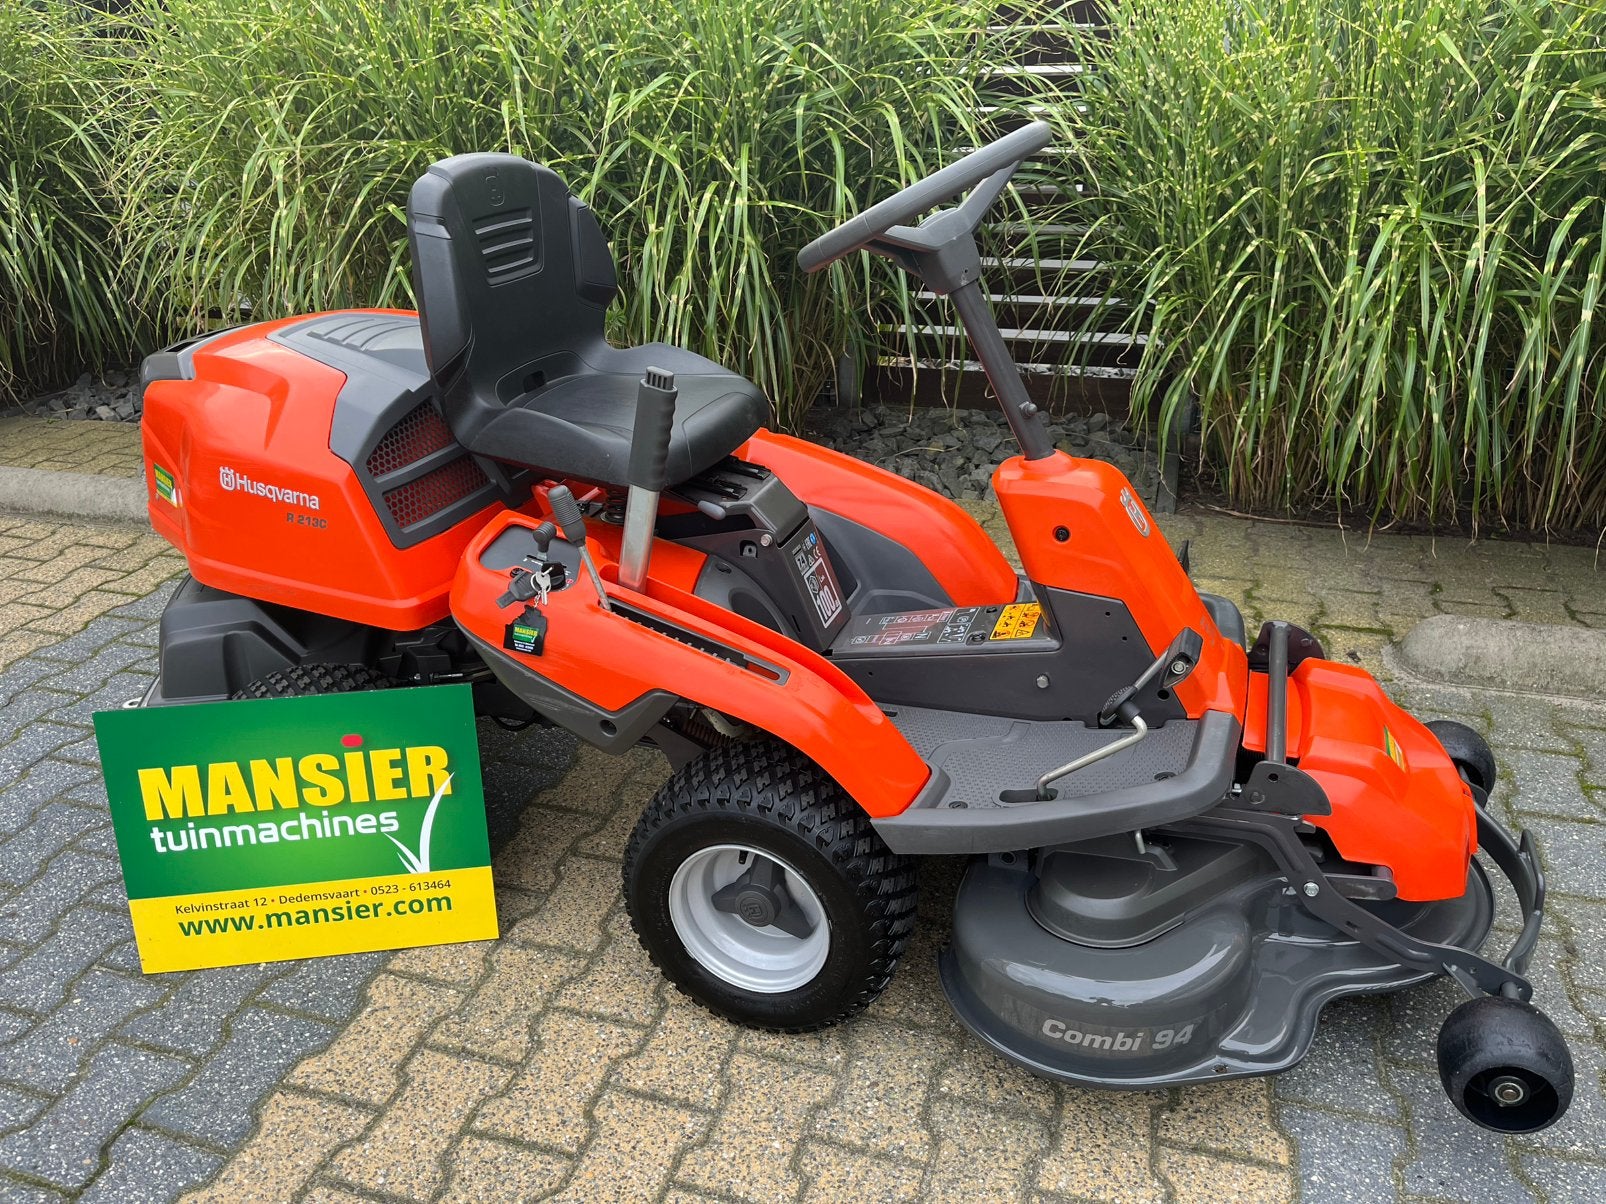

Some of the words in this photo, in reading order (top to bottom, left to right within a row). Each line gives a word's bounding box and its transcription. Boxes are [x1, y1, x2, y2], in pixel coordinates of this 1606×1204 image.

[236, 473, 320, 510] Husqvarna
[286, 512, 295, 523] R
[298, 514, 328, 529] 213C
[816, 585, 836, 620] 100
[137, 734, 453, 821] MANSIER
[150, 810, 399, 853] tuinmachines
[175, 900, 250, 915] Kelvinstraat
[254, 897, 268, 907] 12
[279, 888, 360, 905] Dedemsvaart
[370, 884, 399, 896] 0523
[409, 879, 452, 892] 613464
[178, 895, 453, 937] www.mansier.com
[1042, 1019, 1144, 1051] Combi
[1152, 1023, 1195, 1050] 94
